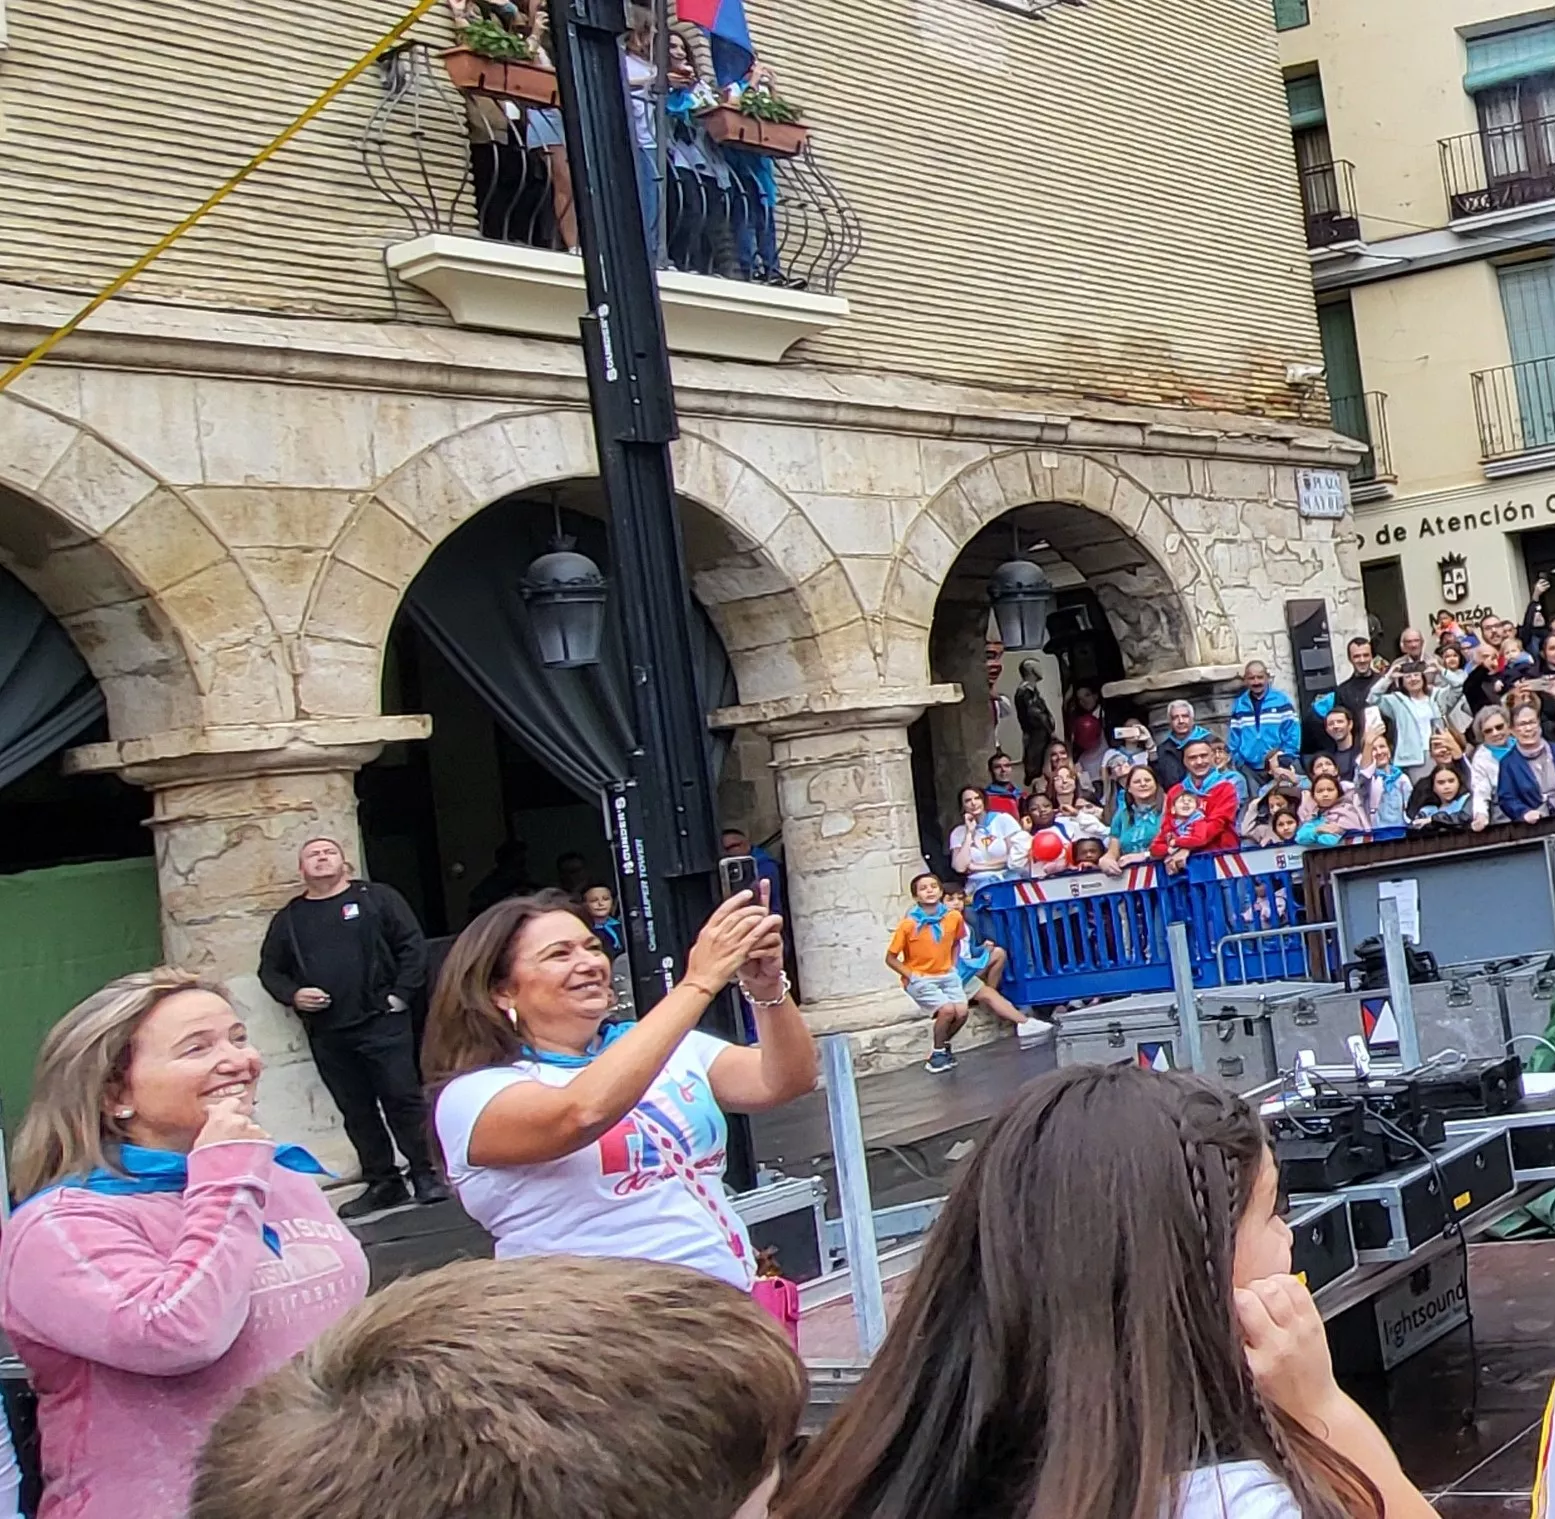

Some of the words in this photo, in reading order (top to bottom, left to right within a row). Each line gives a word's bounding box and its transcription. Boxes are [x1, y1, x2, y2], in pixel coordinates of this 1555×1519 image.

[1375, 523, 1407, 545] de
[1419, 501, 1535, 539] Atención
[1429, 604, 1493, 629] Mnzón
[634, 838, 648, 879] TOWER
[640, 880, 653, 919] SUPER
[1384, 1273, 1466, 1348] lightsound
